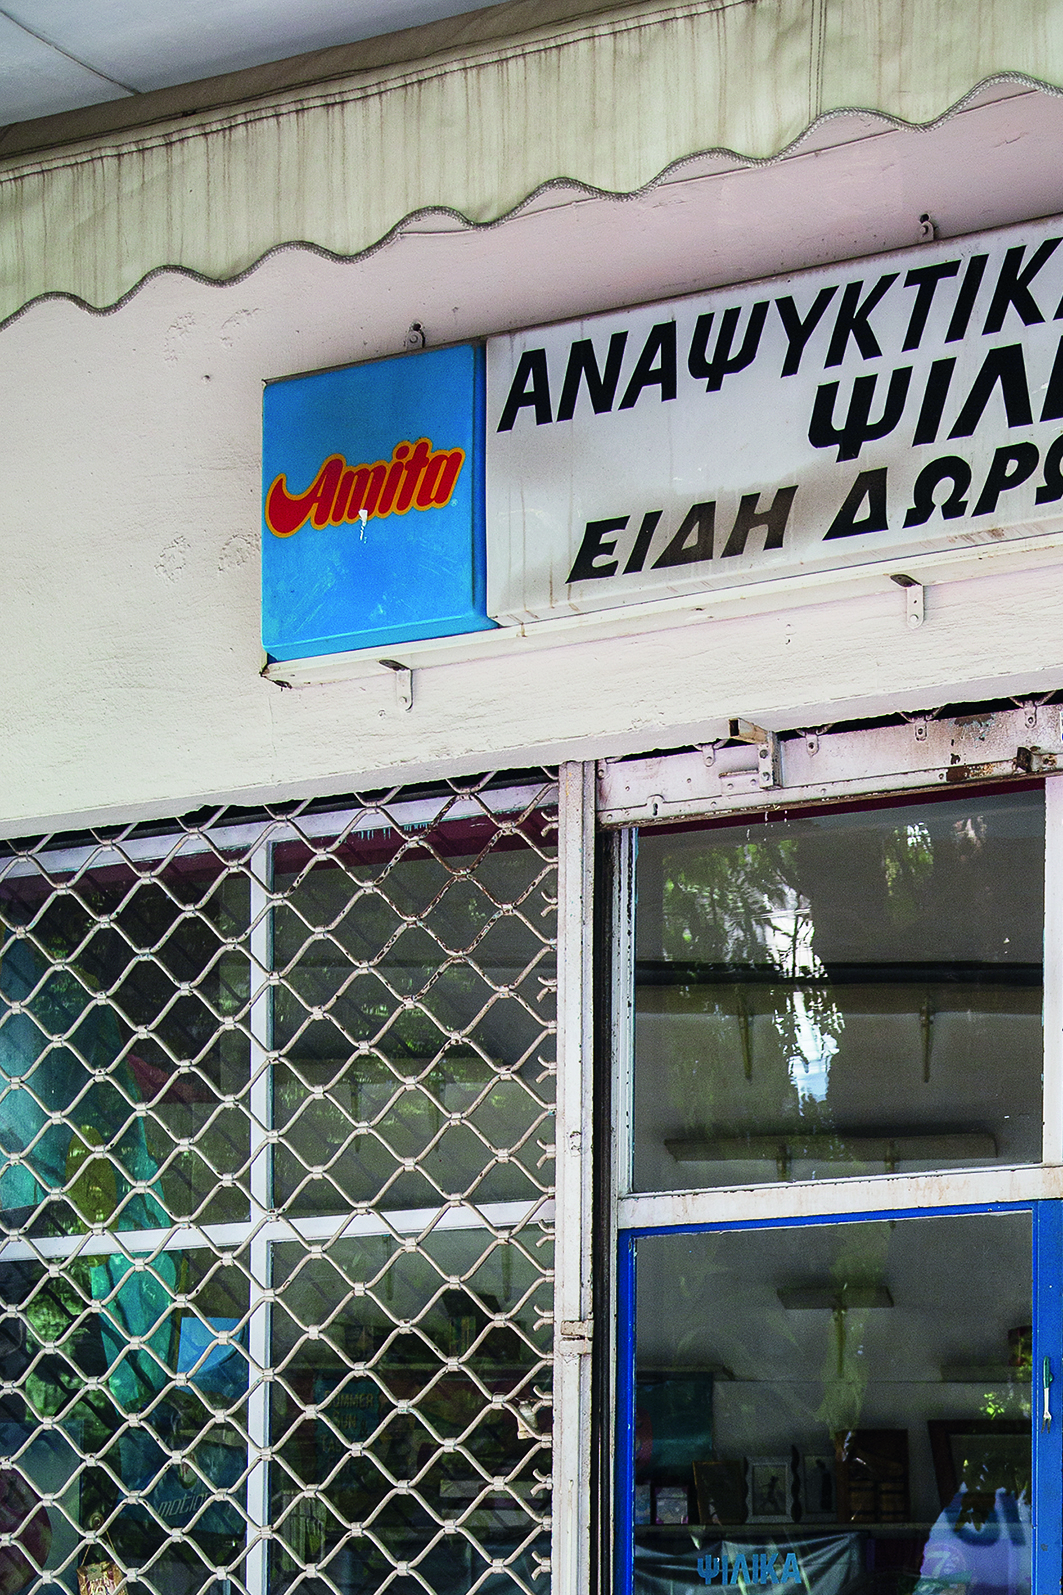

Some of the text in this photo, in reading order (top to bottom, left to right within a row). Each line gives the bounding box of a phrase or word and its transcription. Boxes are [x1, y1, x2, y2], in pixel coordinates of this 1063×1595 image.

[264, 437, 466, 539] Amita
[565, 485, 799, 584] ΕΙΔΗ
[697, 1552, 802, 1585] ΨΙΛΙΚΑ
